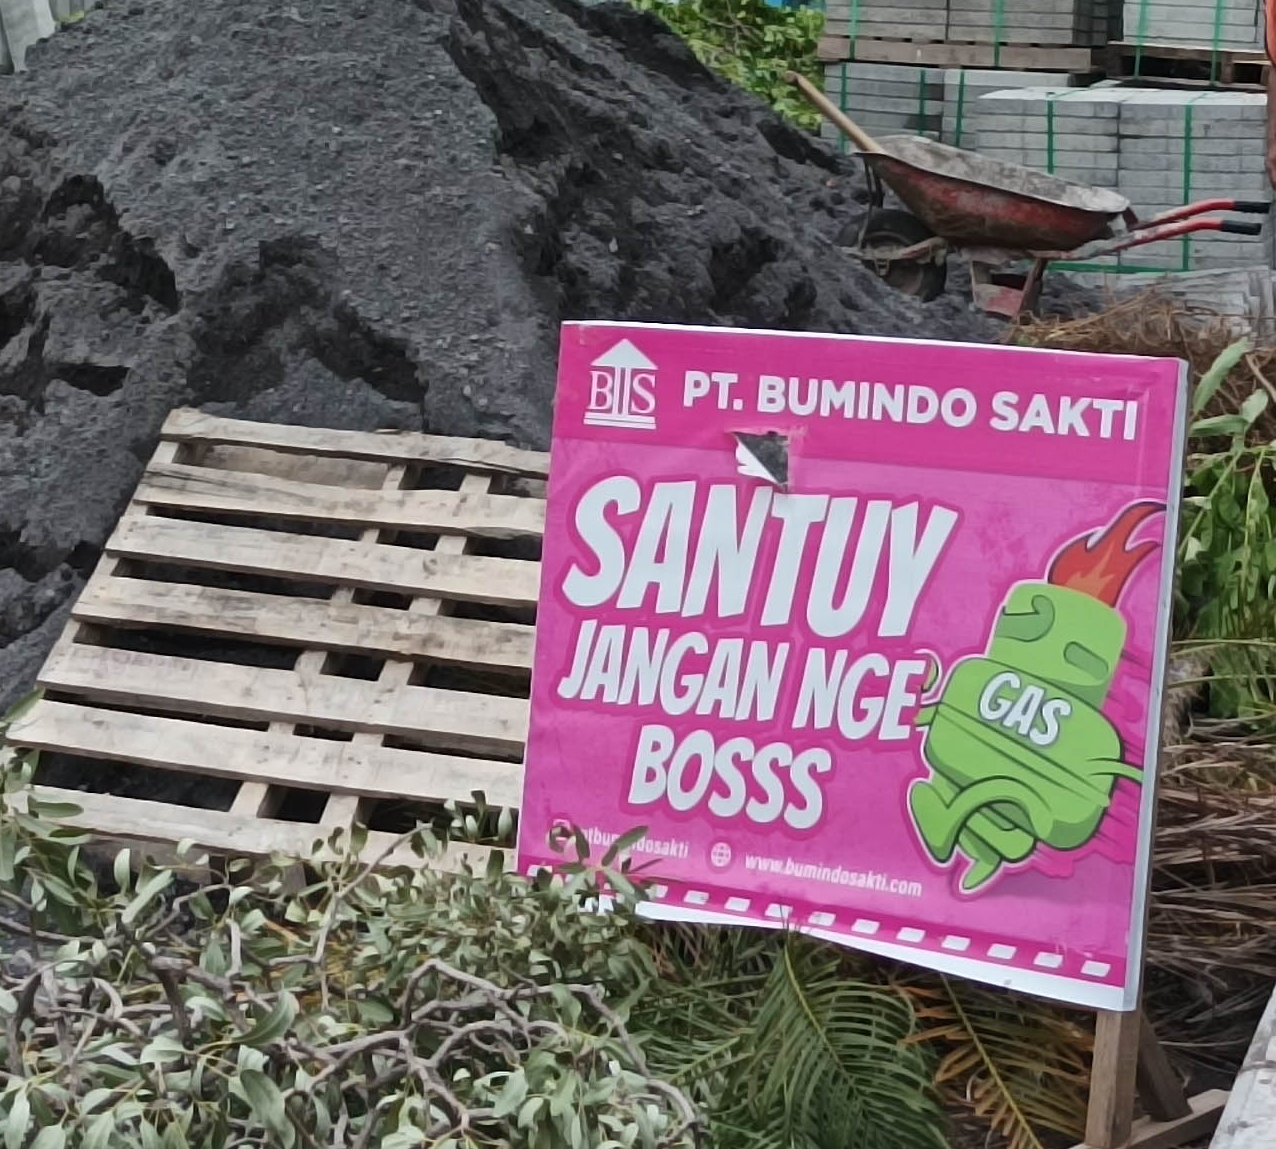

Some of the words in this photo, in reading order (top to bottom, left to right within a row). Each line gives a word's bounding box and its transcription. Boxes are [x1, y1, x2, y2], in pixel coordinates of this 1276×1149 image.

[683, 370, 744, 411] PT.
[757, 375, 978, 428] BUMINDO
[989, 391, 1139, 441] SAKTI
[562, 475, 959, 638] SANTUY
[558, 619, 788, 722] JANGAN
[792, 648, 925, 741] NGE
[979, 672, 1072, 745] GAS
[627, 724, 832, 829] BOSSS
[744, 853, 923, 898] www.bumindosakti.com
